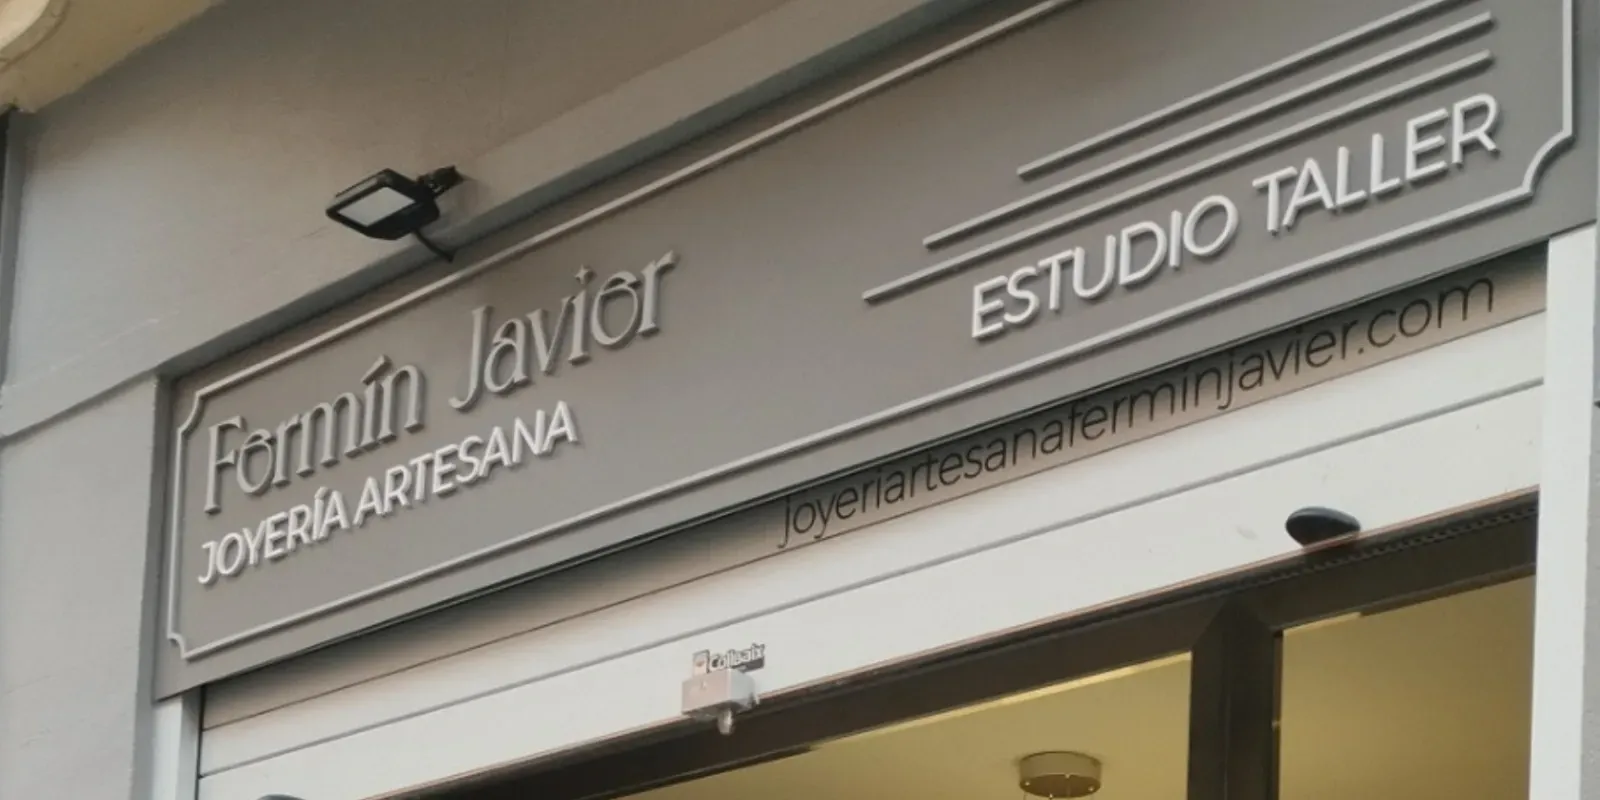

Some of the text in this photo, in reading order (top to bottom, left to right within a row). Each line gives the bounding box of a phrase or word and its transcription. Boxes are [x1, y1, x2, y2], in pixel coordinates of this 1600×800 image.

[972, 93, 1499, 339] ESTUDIO TALLER
[197, 400, 579, 585] JOYERÍA ARTESANA
[777, 277, 1494, 548] joyeriartesanaferminjavier.com
